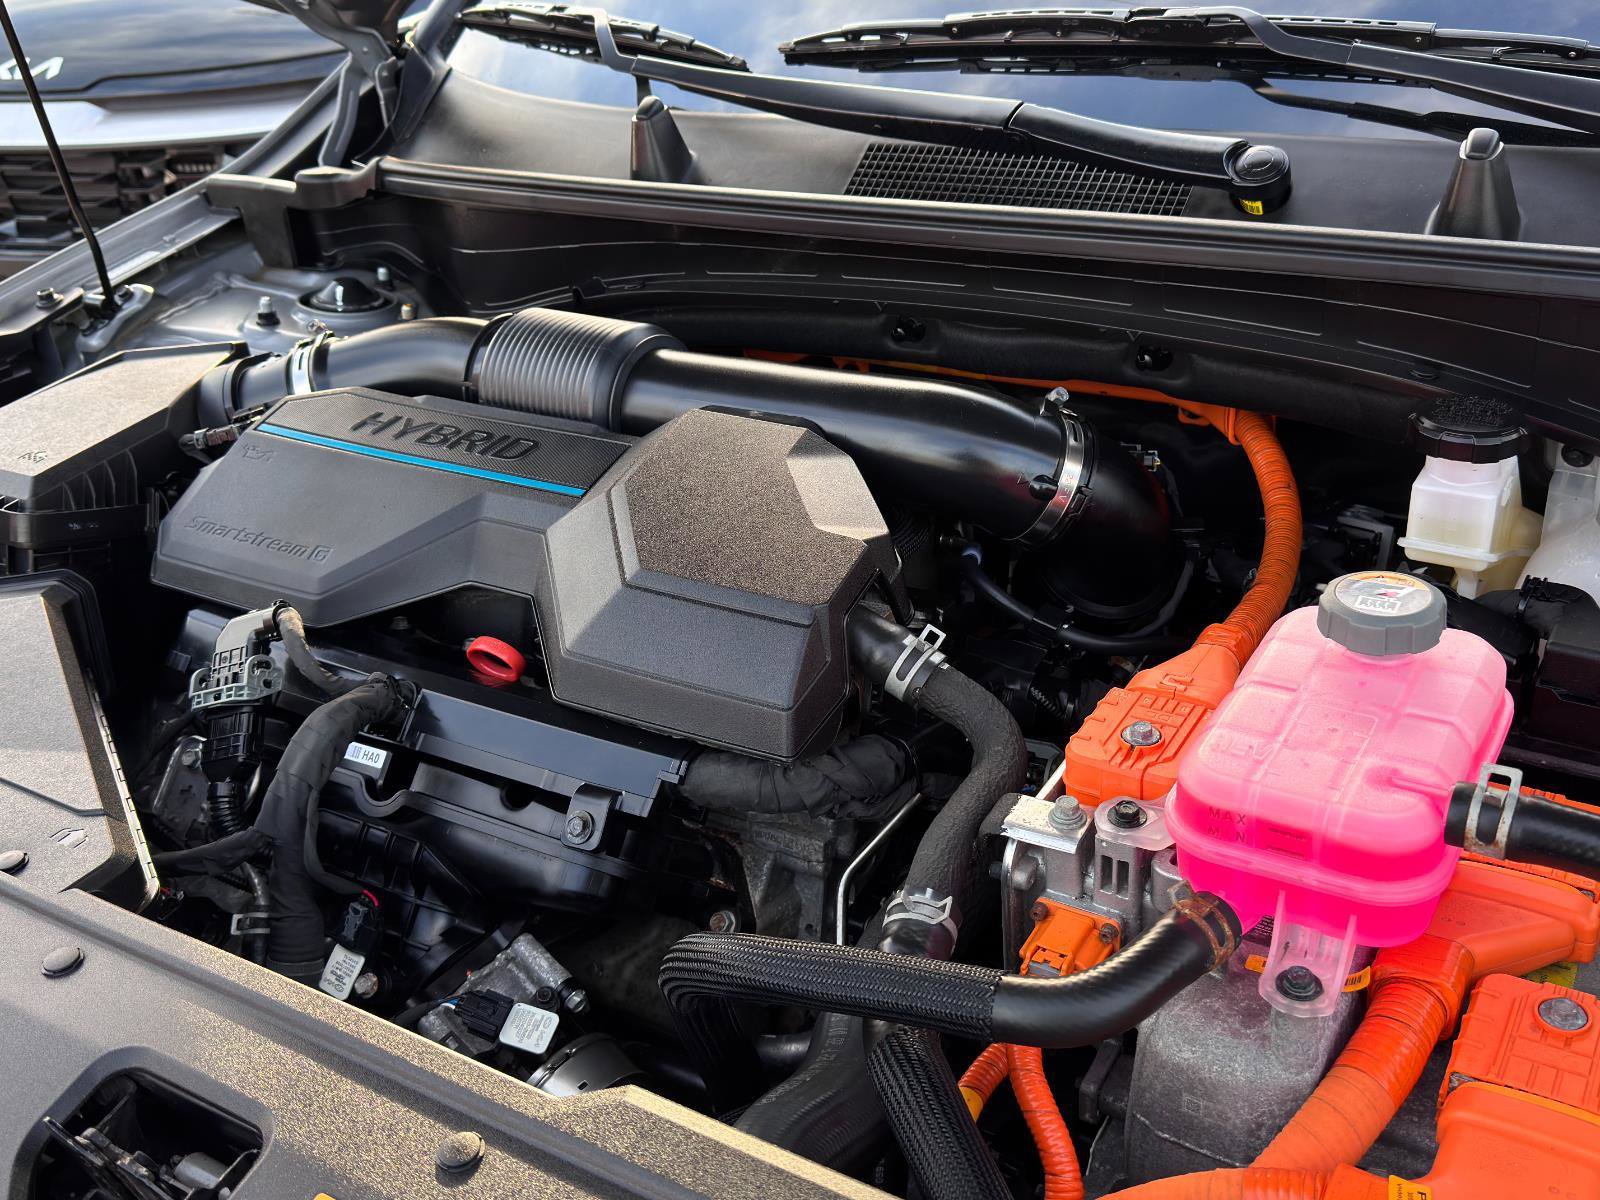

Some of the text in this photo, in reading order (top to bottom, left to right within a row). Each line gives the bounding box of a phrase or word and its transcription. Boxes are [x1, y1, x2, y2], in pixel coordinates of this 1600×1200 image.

[350, 411, 541, 461] HYBRID
[184, 515, 309, 558] Smartstream
[1208, 806, 1247, 825] MAX
[1207, 825, 1246, 842] MN
